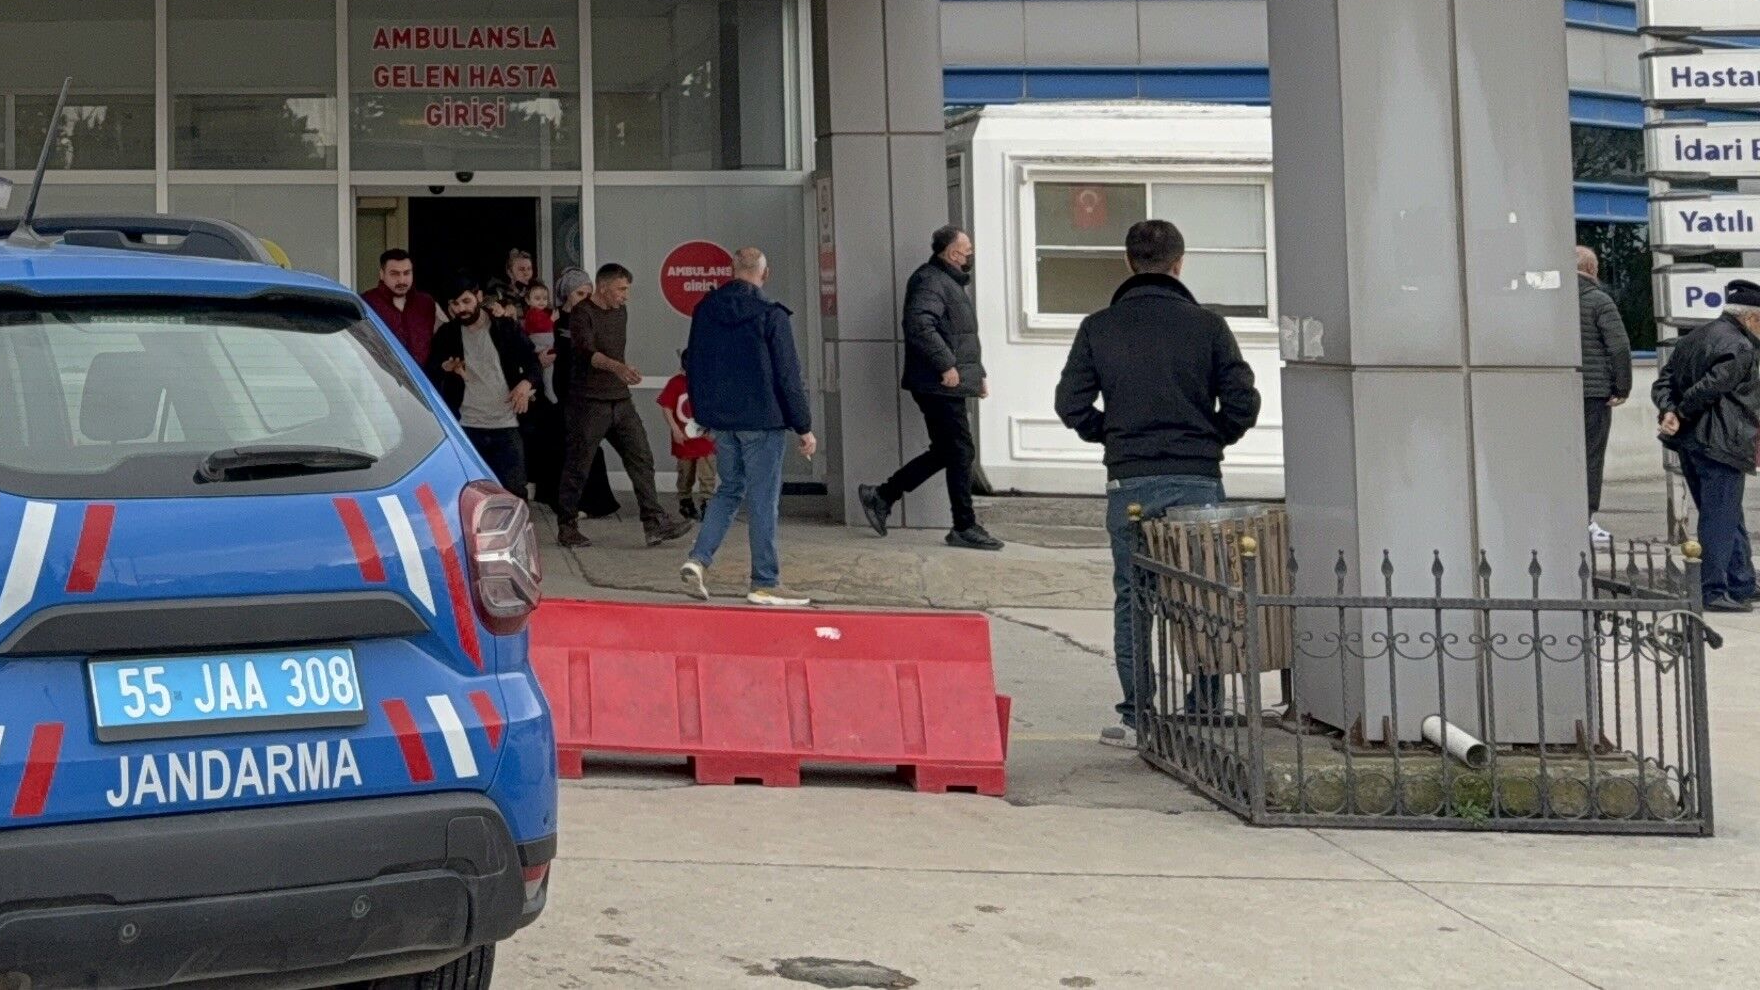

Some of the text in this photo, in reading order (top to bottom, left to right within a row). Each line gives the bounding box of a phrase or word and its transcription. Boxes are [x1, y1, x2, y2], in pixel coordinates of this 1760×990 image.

[372, 25, 557, 50] AMBULANSLA
[373, 65, 558, 88] GELEN HASTA
[1671, 66, 1760, 88] Hasta
[425, 97, 506, 130] GİRİŞİ
[1675, 134, 1742, 160] İdari
[1679, 210, 1753, 232] Yatılı
[117, 656, 354, 718] 55 JAA 308
[106, 738, 362, 807] JANDARMA
